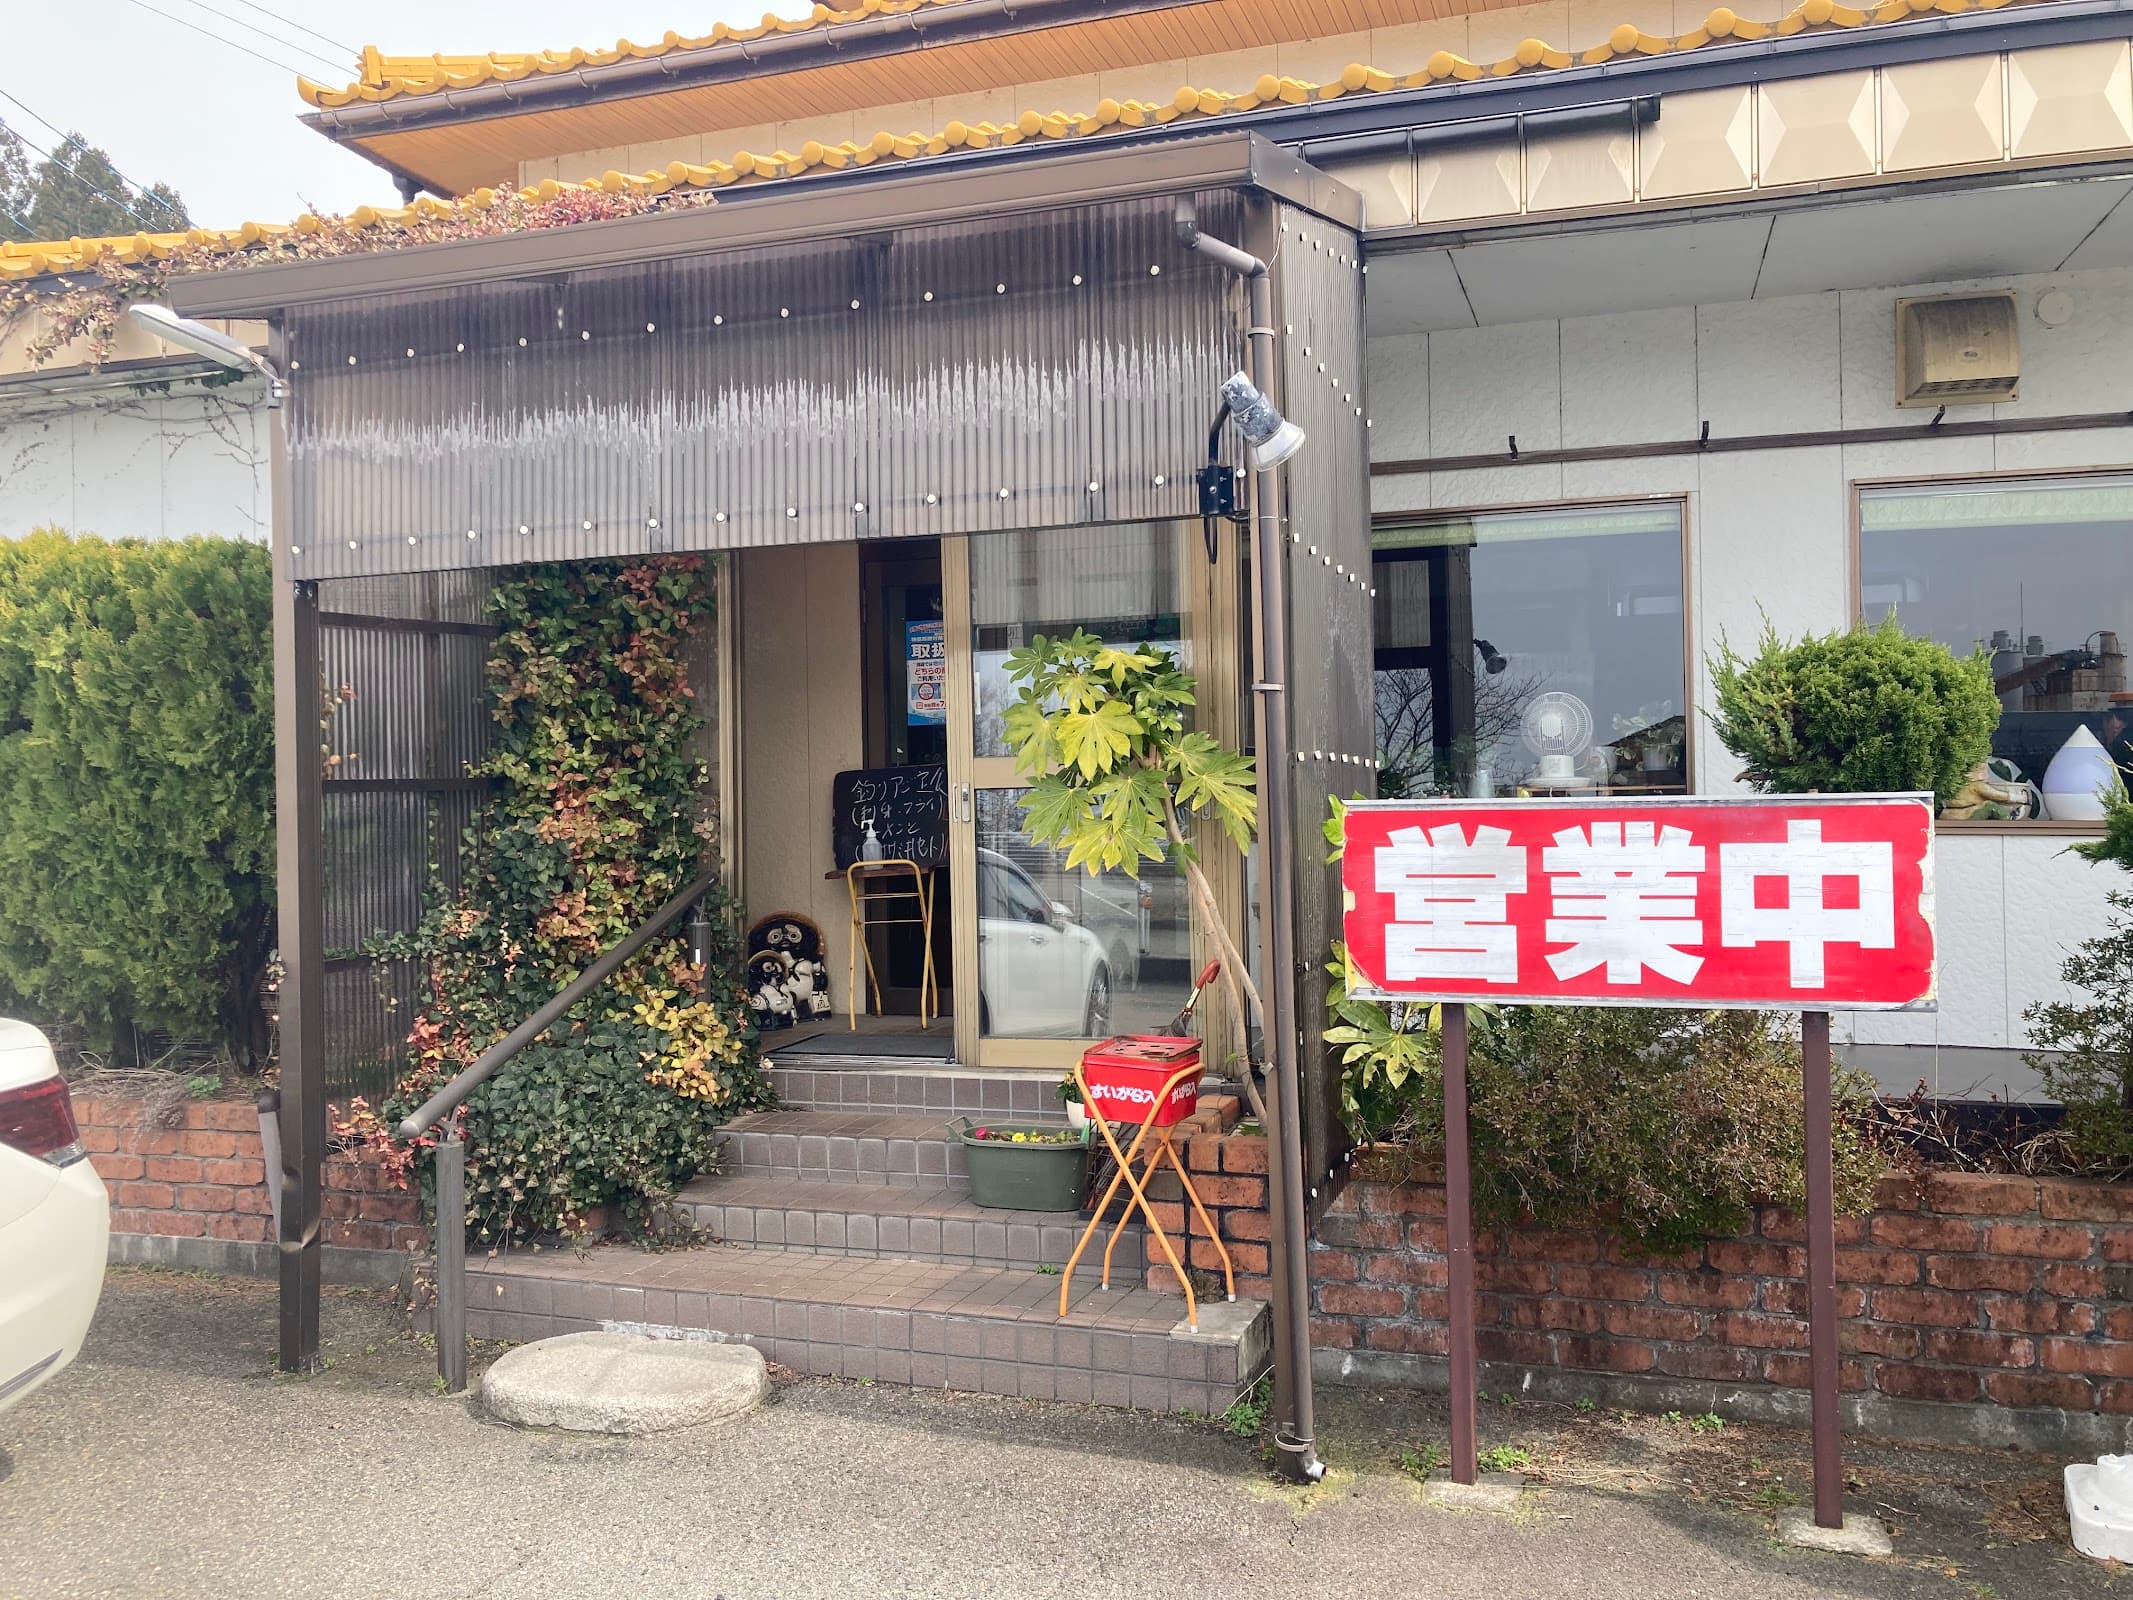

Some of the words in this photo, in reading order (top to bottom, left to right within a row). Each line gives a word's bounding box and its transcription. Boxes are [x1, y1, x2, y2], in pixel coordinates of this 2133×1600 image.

[1374, 819, 1895, 988] 営業中
[1090, 1083, 1156, 1104] すいがら入
